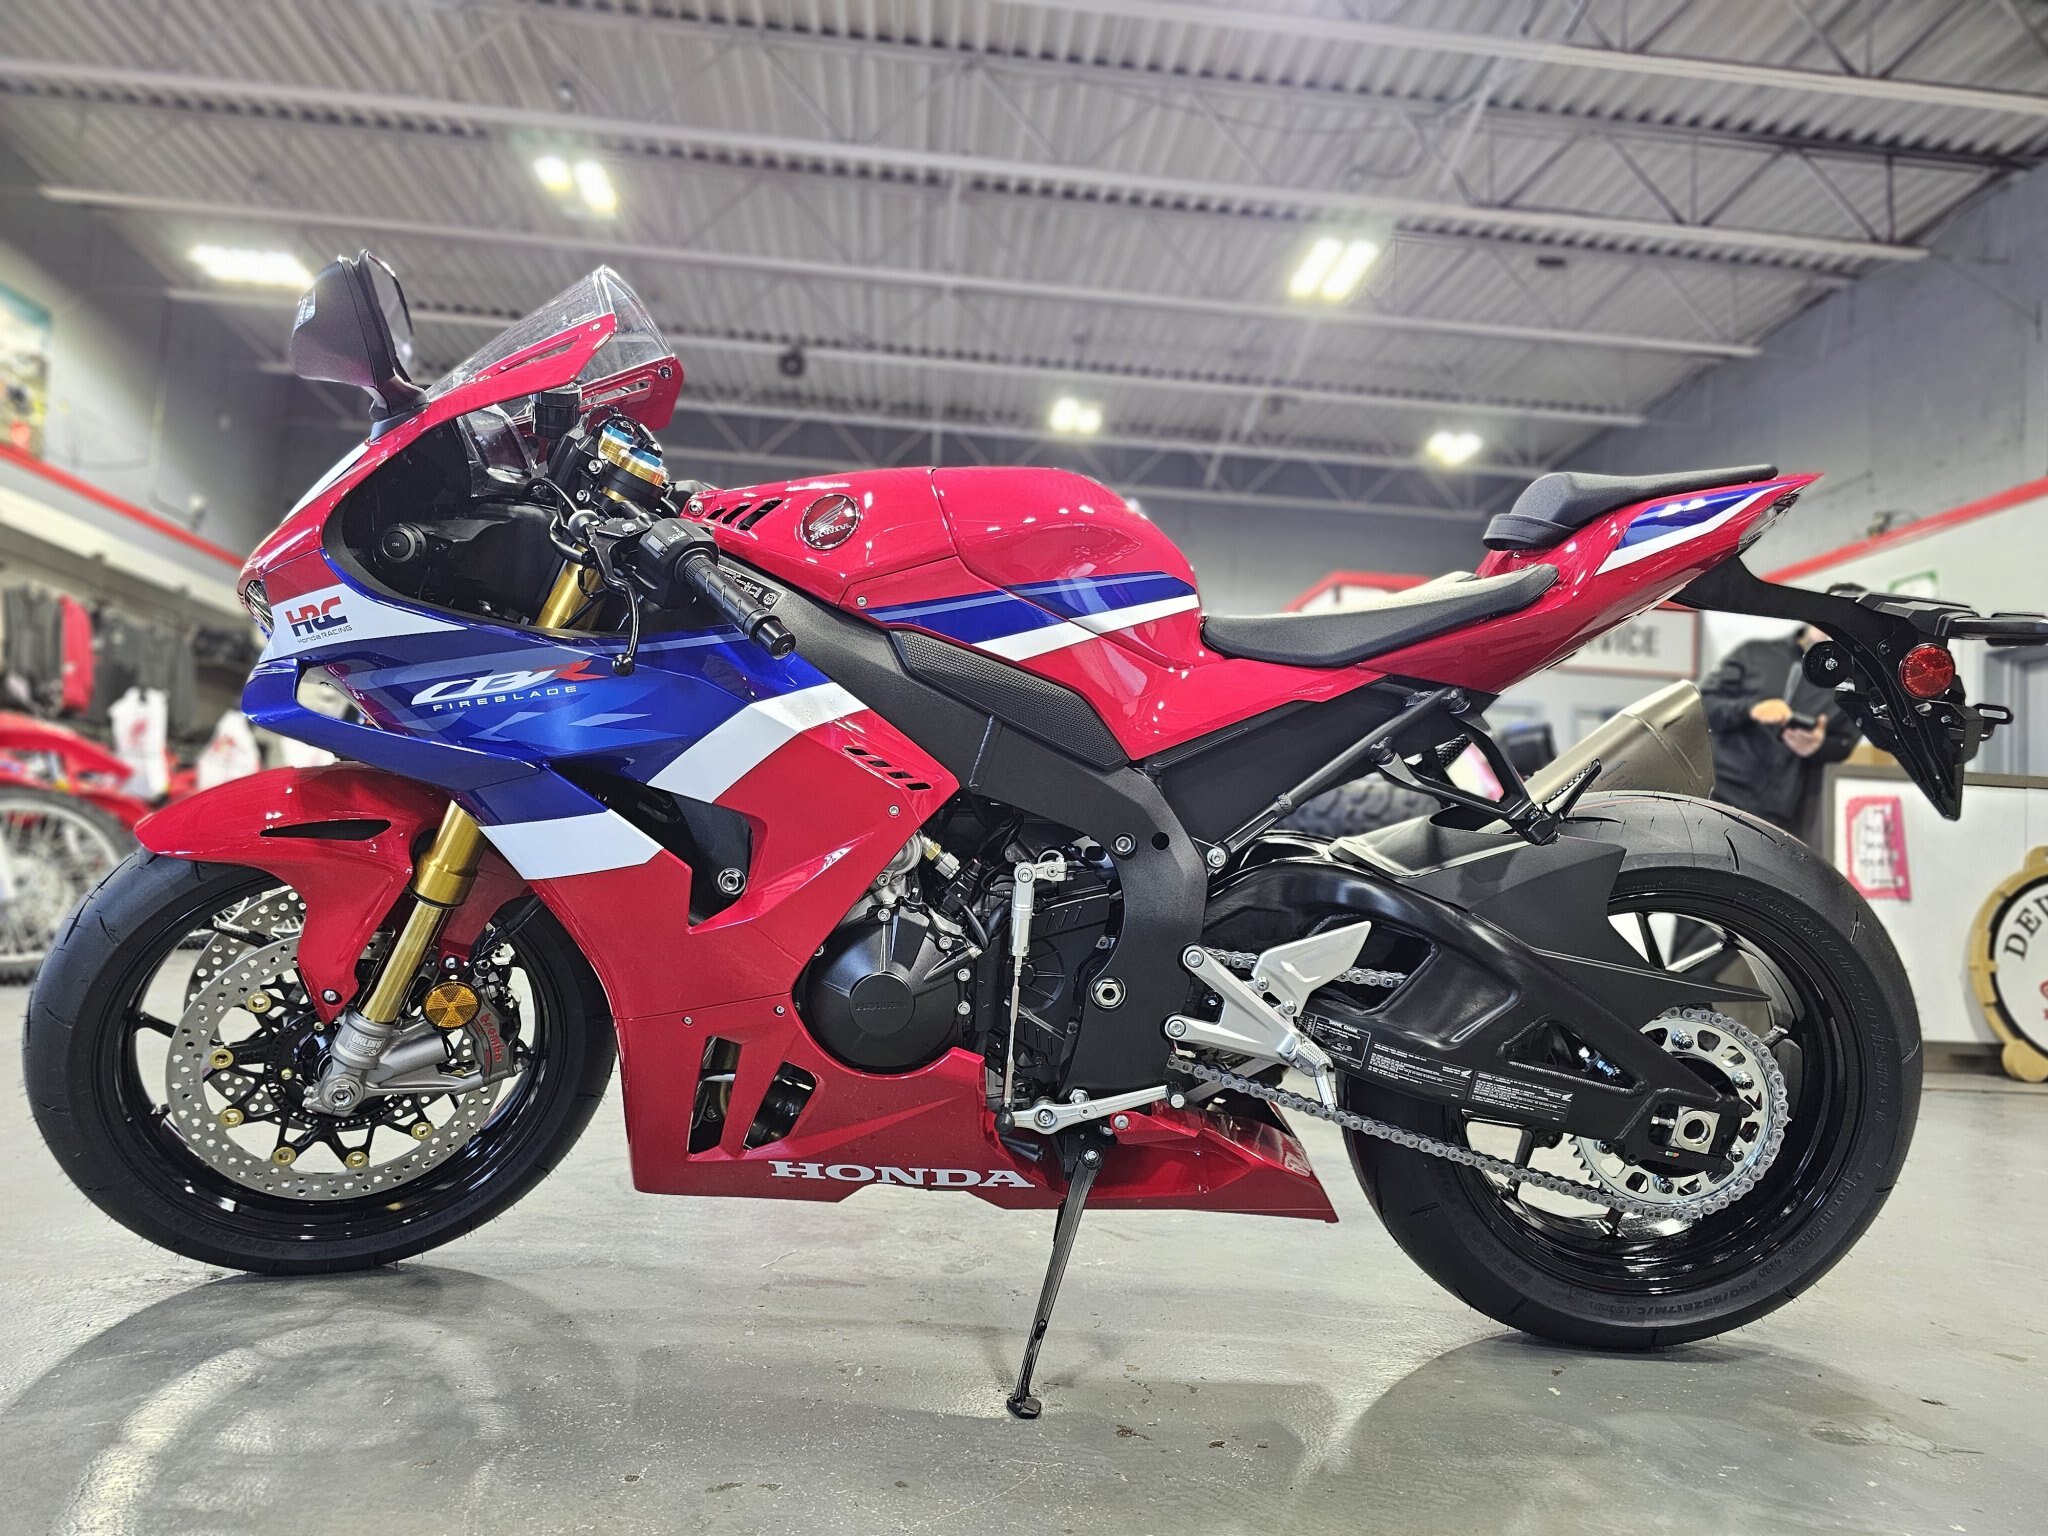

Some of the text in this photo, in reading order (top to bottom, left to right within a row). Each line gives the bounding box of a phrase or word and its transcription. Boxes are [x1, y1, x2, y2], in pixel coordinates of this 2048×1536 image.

[285, 596, 348, 637] HRC
[320, 625, 353, 639] RACING
[1586, 624, 1661, 658] VICE
[411, 660, 609, 706] CBR
[432, 685, 577, 712] FIREBLADE
[480, 1012, 508, 1063] brembo
[768, 1160, 1035, 1188] HONDA
